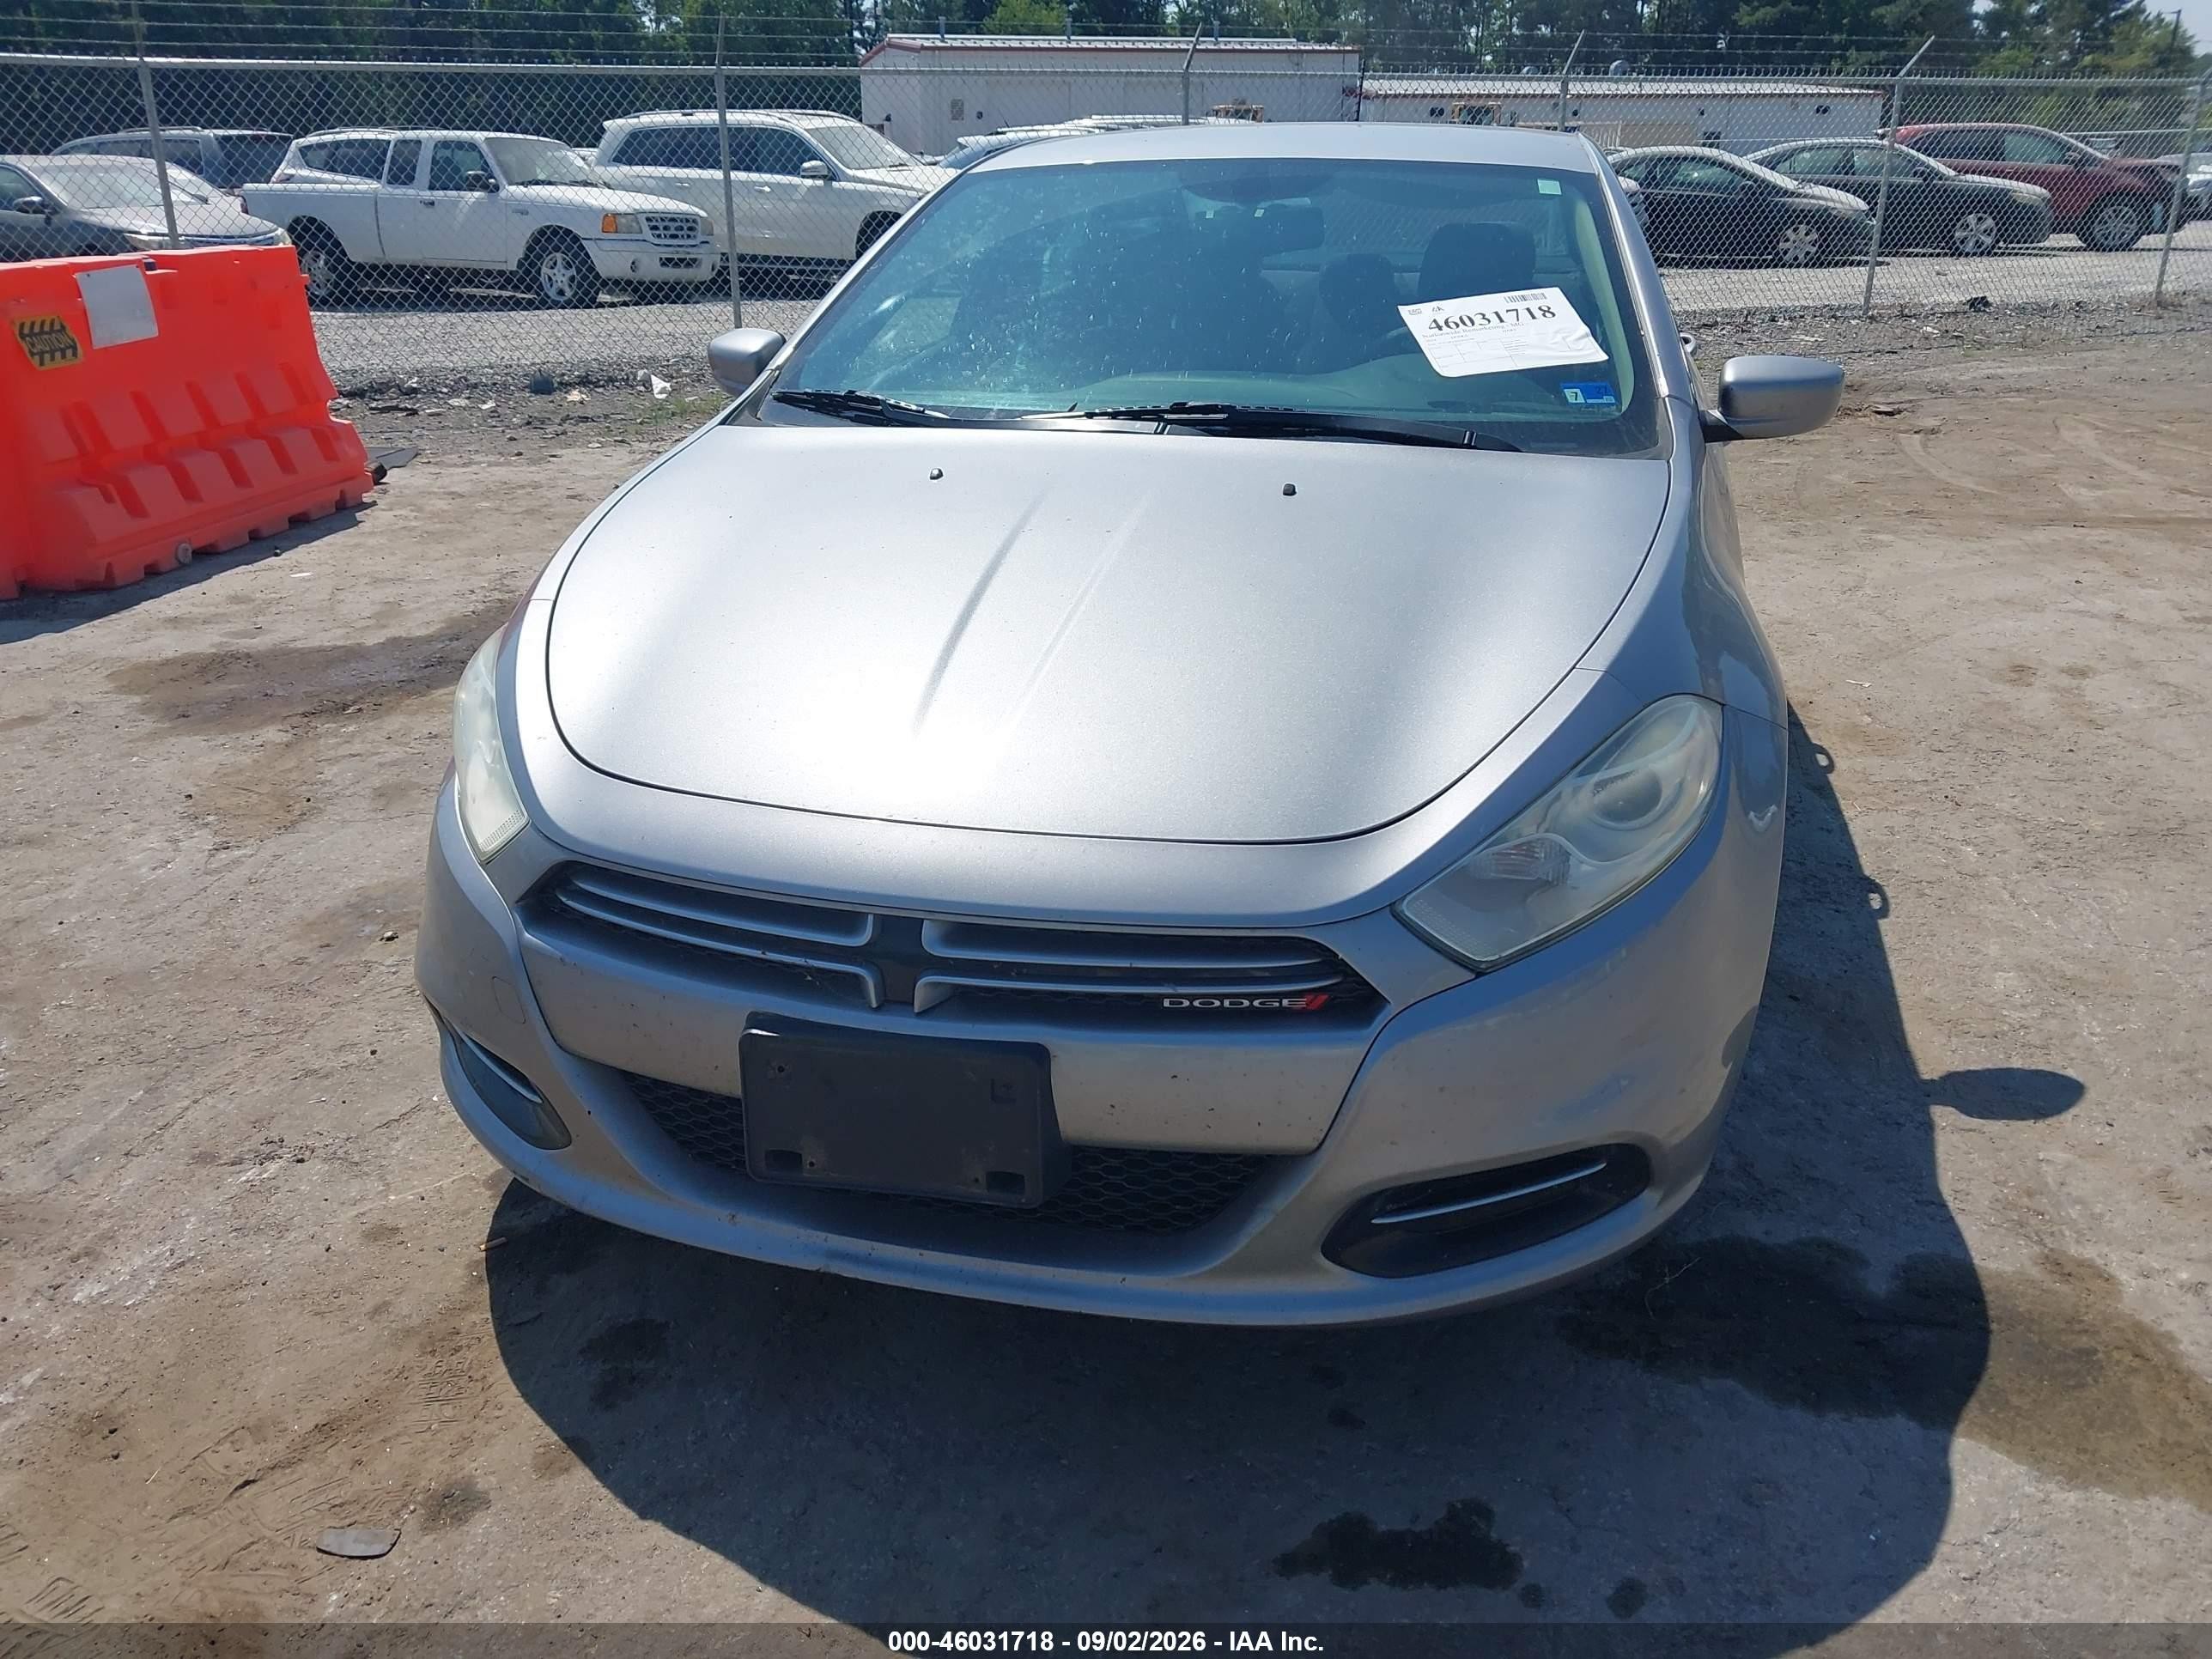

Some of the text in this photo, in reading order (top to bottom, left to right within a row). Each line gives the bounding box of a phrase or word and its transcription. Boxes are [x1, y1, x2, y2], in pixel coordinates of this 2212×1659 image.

[1428, 305, 1557, 331] 46031718
[26, 331, 76, 353] CAUTION
[1571, 392, 1578, 401] 7
[1163, 998, 1307, 1008] DODGE
